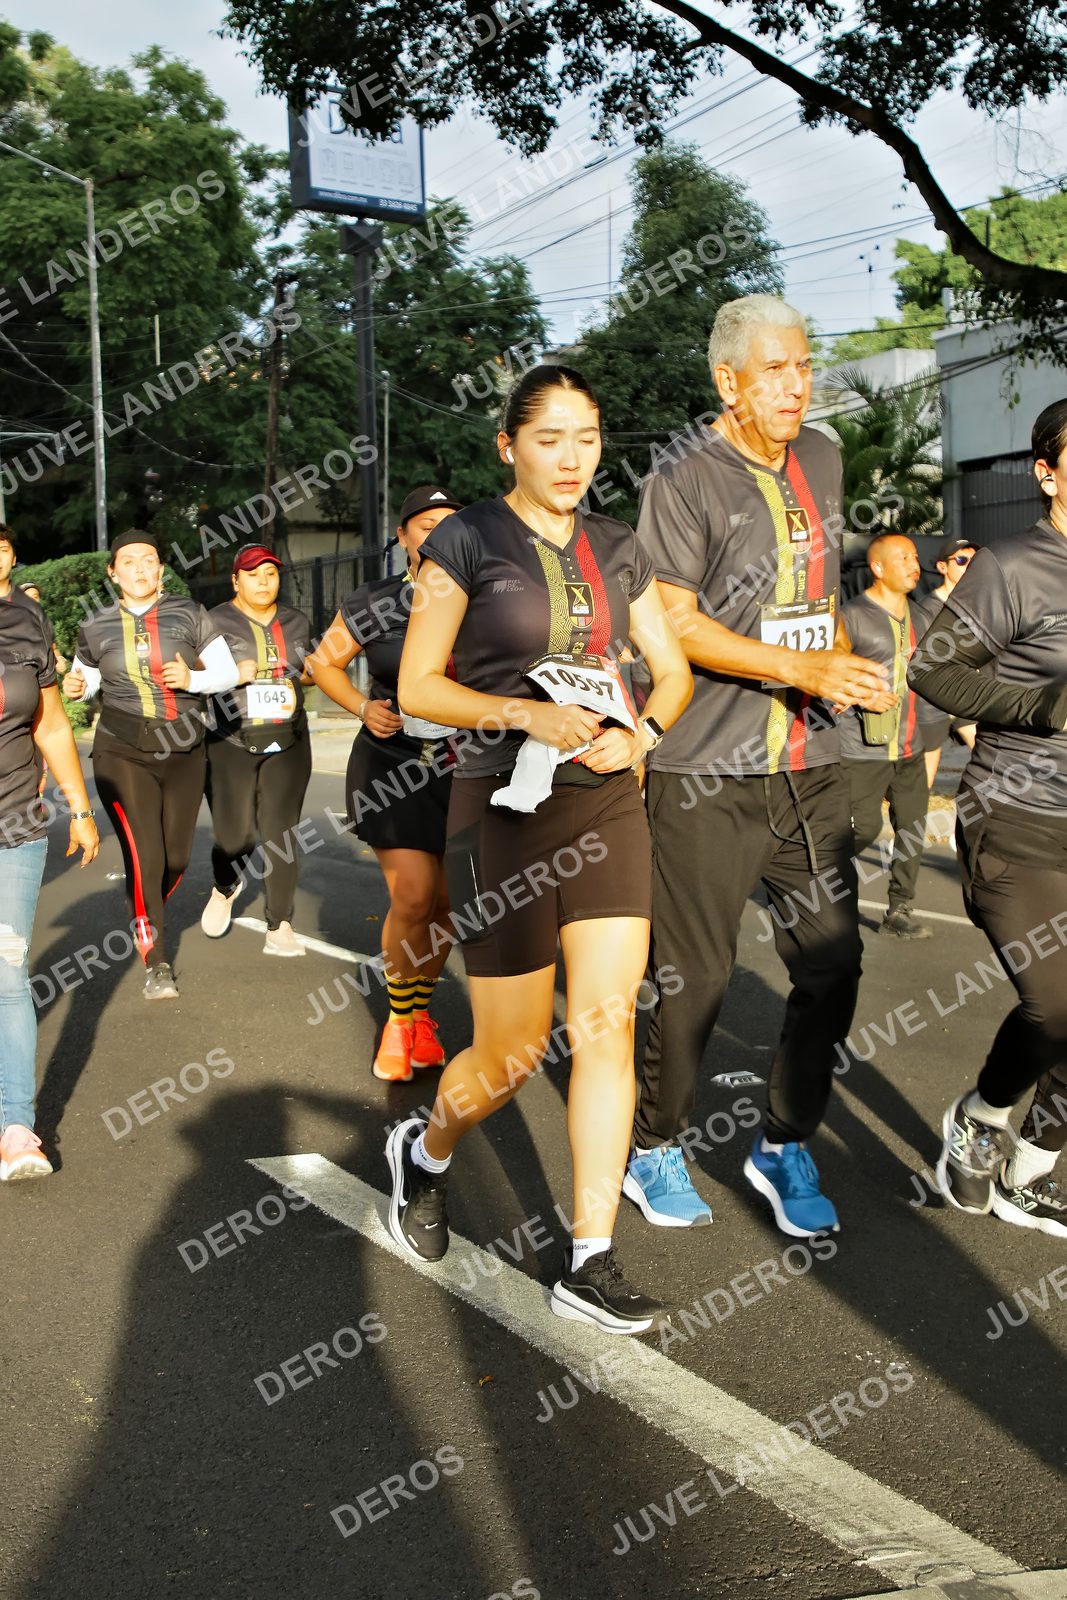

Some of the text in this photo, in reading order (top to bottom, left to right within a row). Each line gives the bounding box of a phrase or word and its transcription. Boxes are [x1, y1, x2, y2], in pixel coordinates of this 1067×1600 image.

[777, 625, 828, 652] 4123
[256, 690, 287, 704] 1645
[537, 668, 615, 701] 10597
